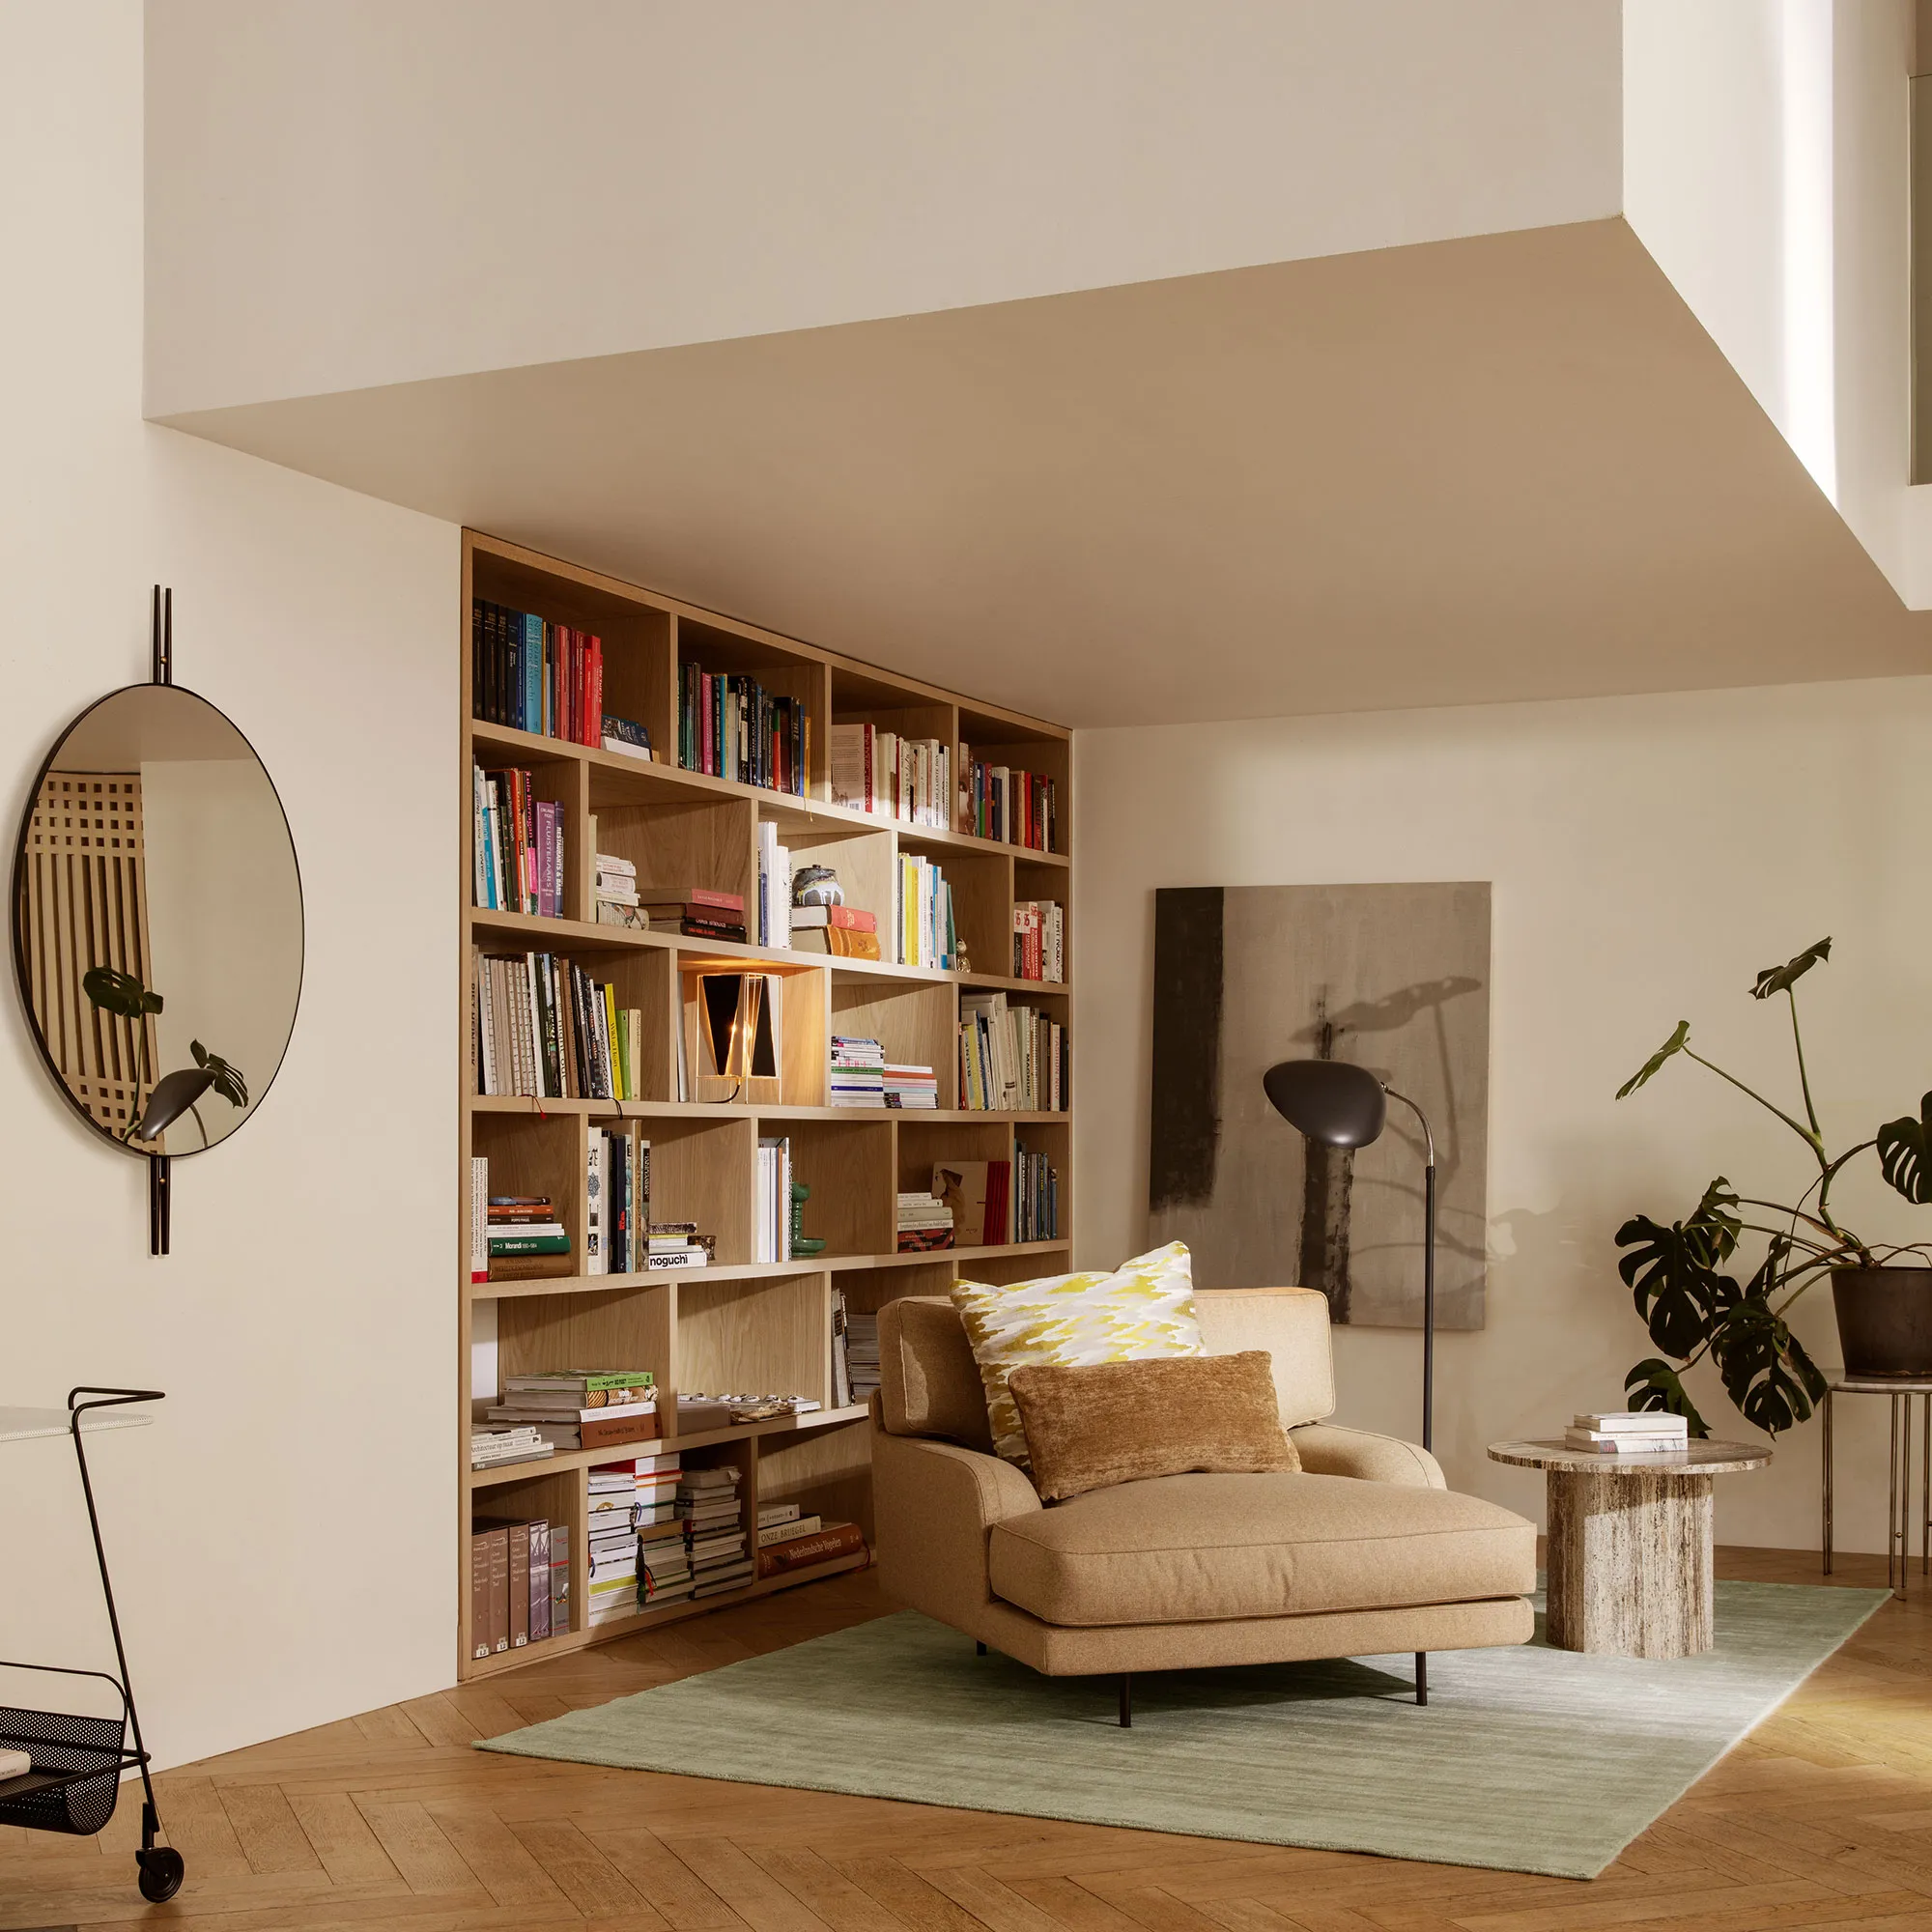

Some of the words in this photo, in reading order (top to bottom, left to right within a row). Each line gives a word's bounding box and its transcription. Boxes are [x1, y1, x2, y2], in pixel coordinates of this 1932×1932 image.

[650, 1254, 689, 1267] noguchi
[761, 1531, 779, 1543] ONZE
[781, 1524, 807, 1539] BRUEGEL
